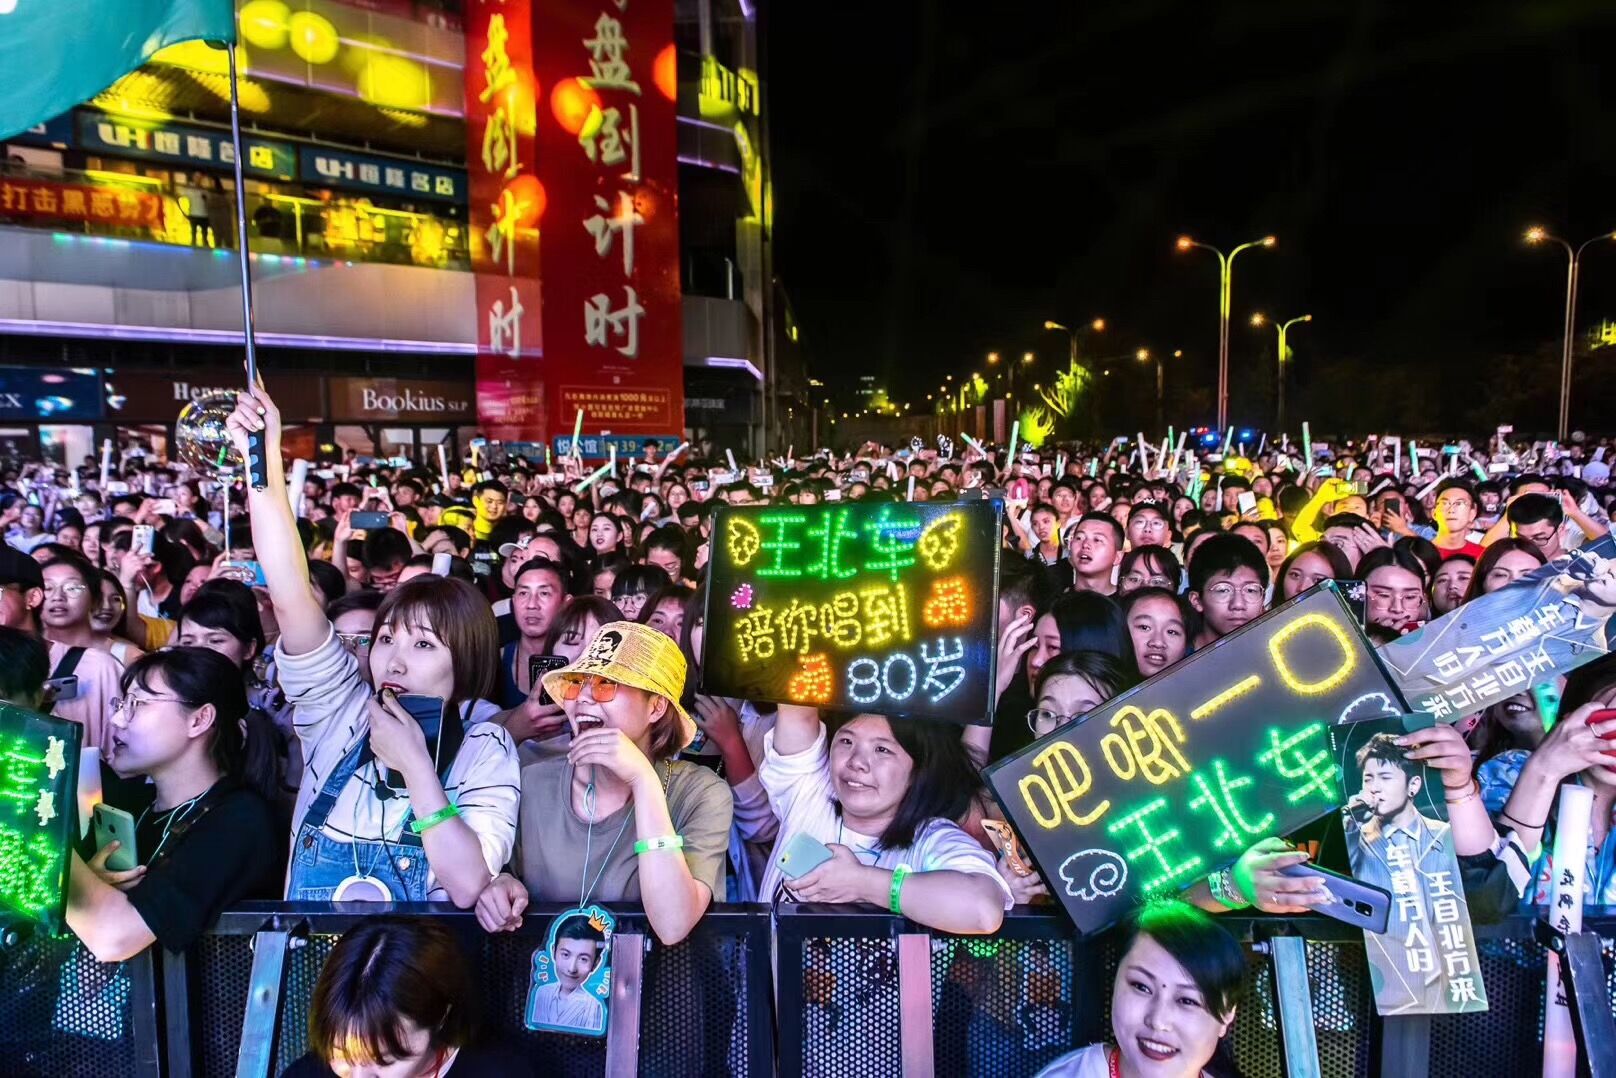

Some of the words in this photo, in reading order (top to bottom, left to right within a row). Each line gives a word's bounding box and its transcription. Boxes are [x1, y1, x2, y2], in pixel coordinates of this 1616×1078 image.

[576, 0, 647, 359] 盘倒计时
[362, 388, 445, 411] Bookius
[448, 401, 468, 411] SLP
[756, 509, 921, 582] 王北车
[734, 583, 912, 663] 陪你唱到
[847, 637, 967, 703] 80岁
[1108, 721, 1339, 893] 王北车
[1428, 870, 1478, 1002] 王自北方来
